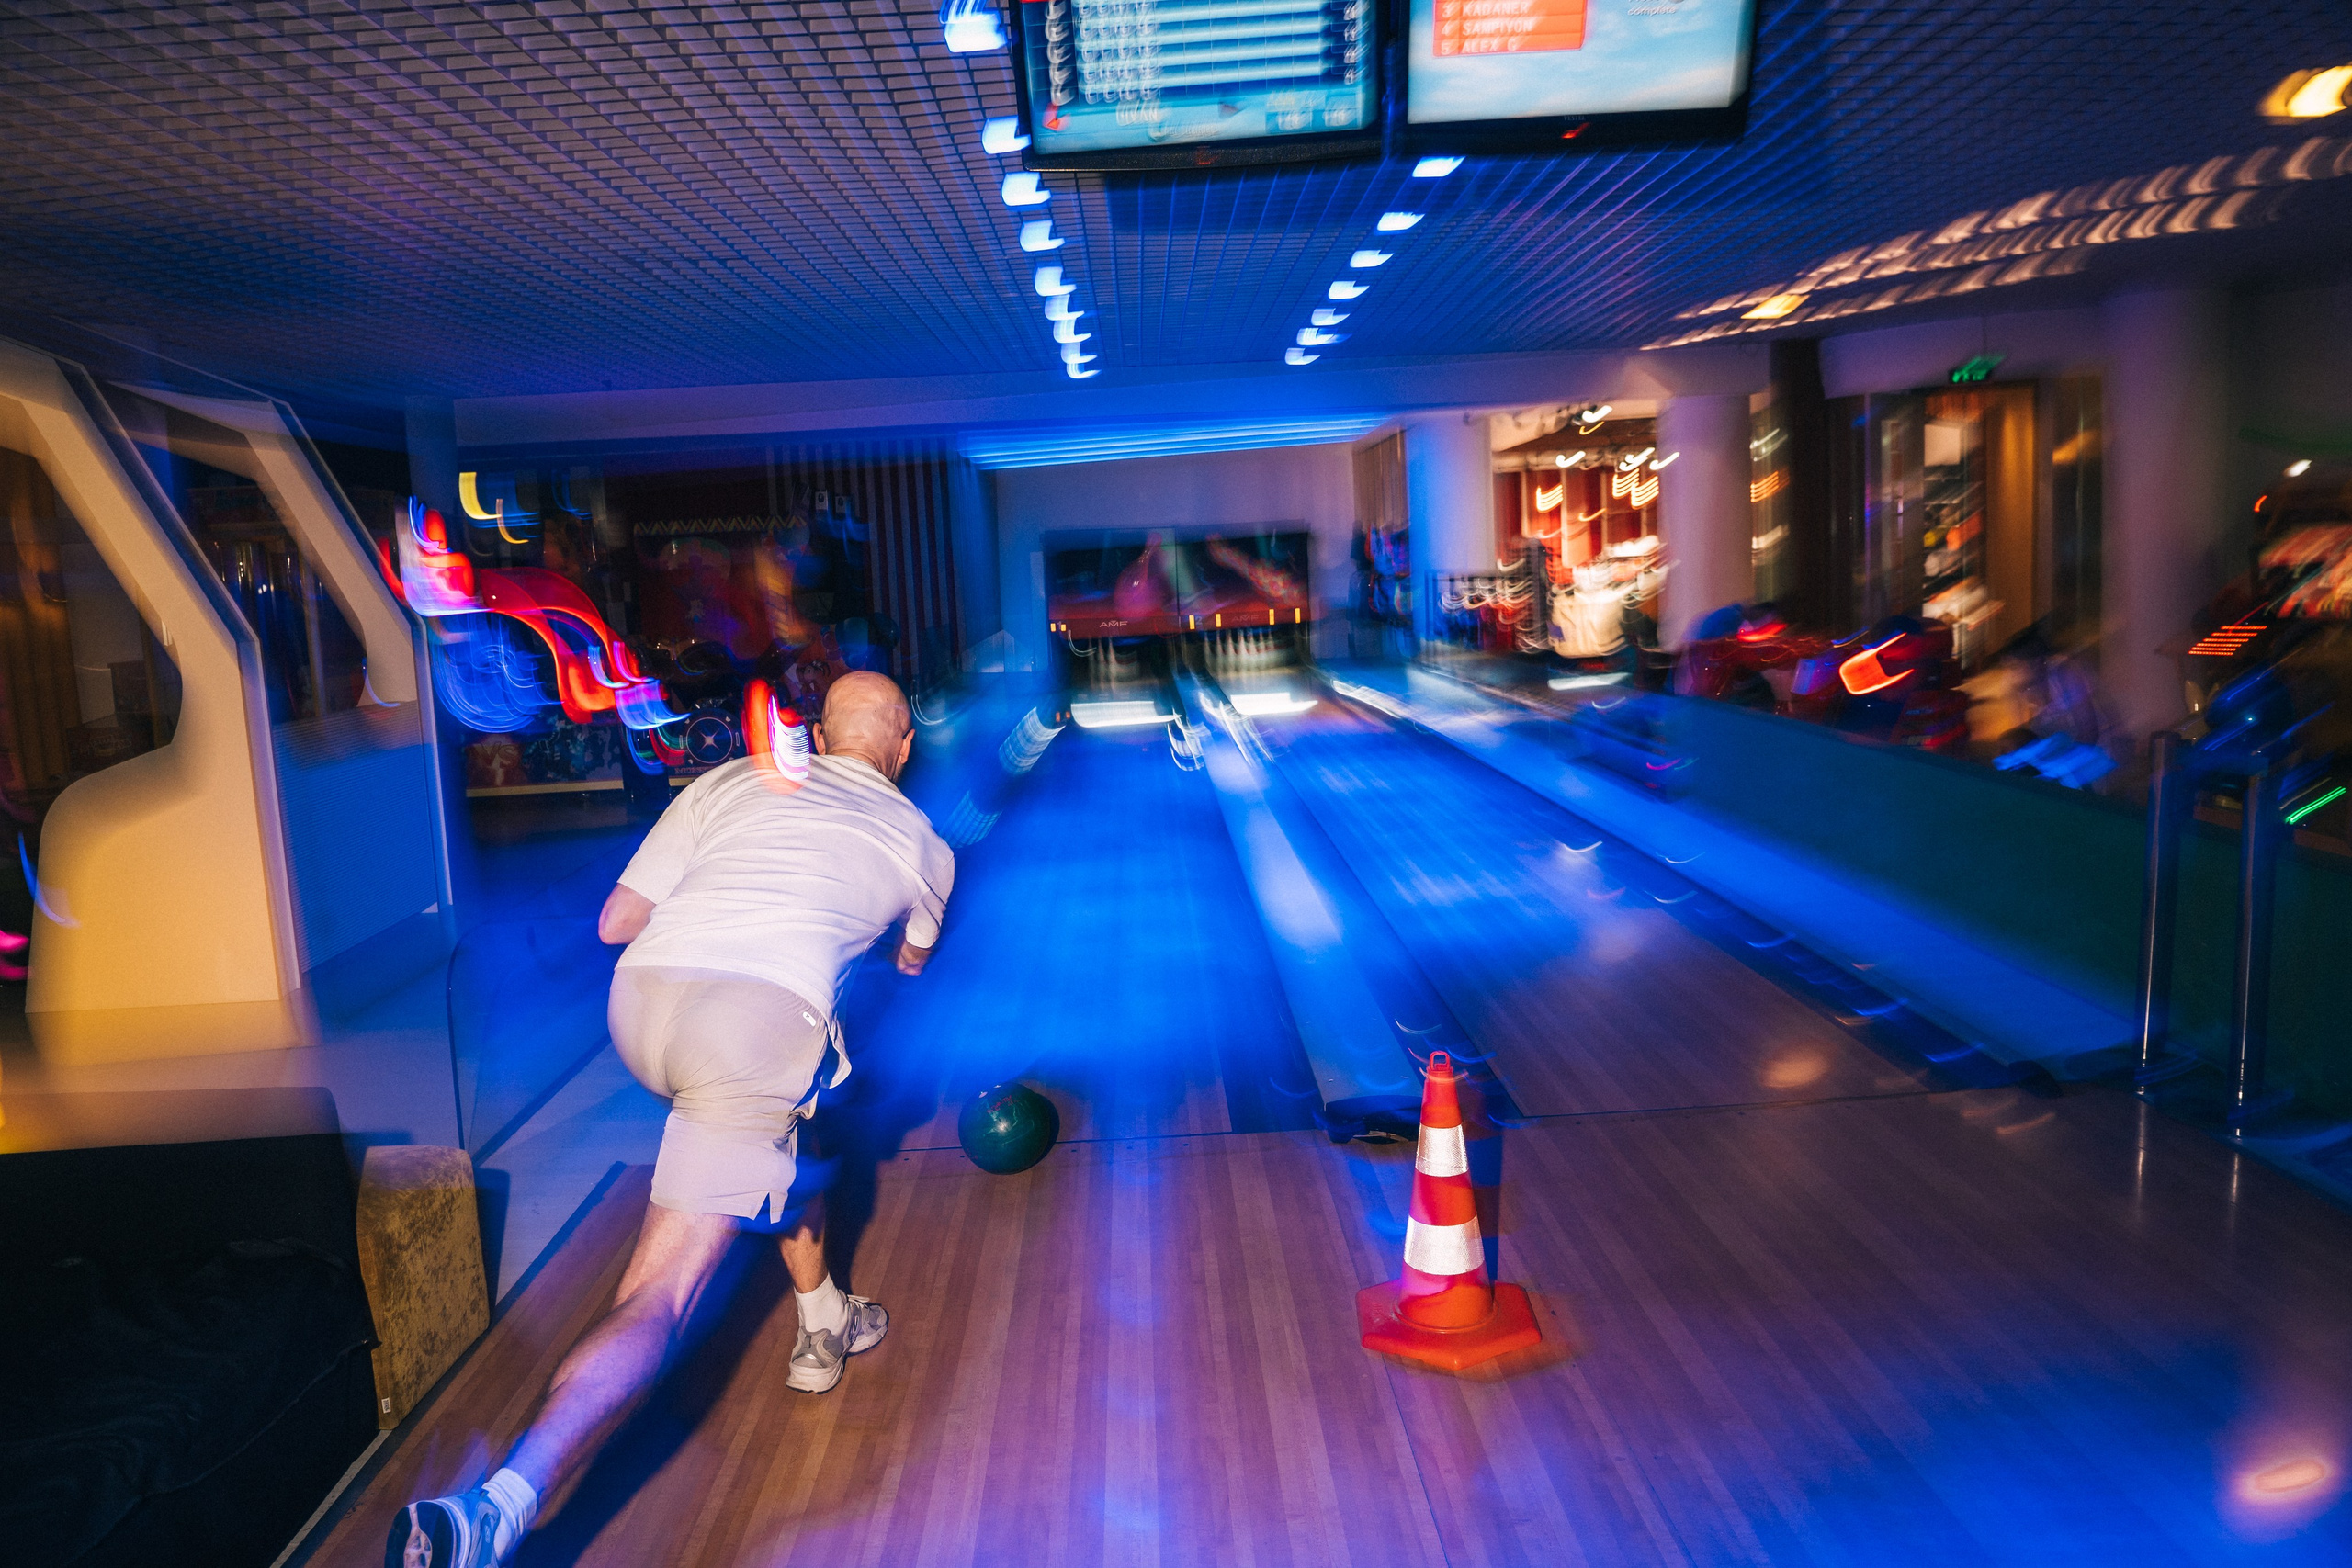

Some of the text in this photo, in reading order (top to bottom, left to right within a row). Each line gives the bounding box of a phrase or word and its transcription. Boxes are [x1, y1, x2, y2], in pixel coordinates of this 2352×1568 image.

[1627, 6, 1677, 17] complete
[1461, 39, 1499, 54] ALEX
[1099, 620, 1128, 628] AMF
[1232, 615, 1259, 623] AMF
[475, 740, 520, 770] VS
